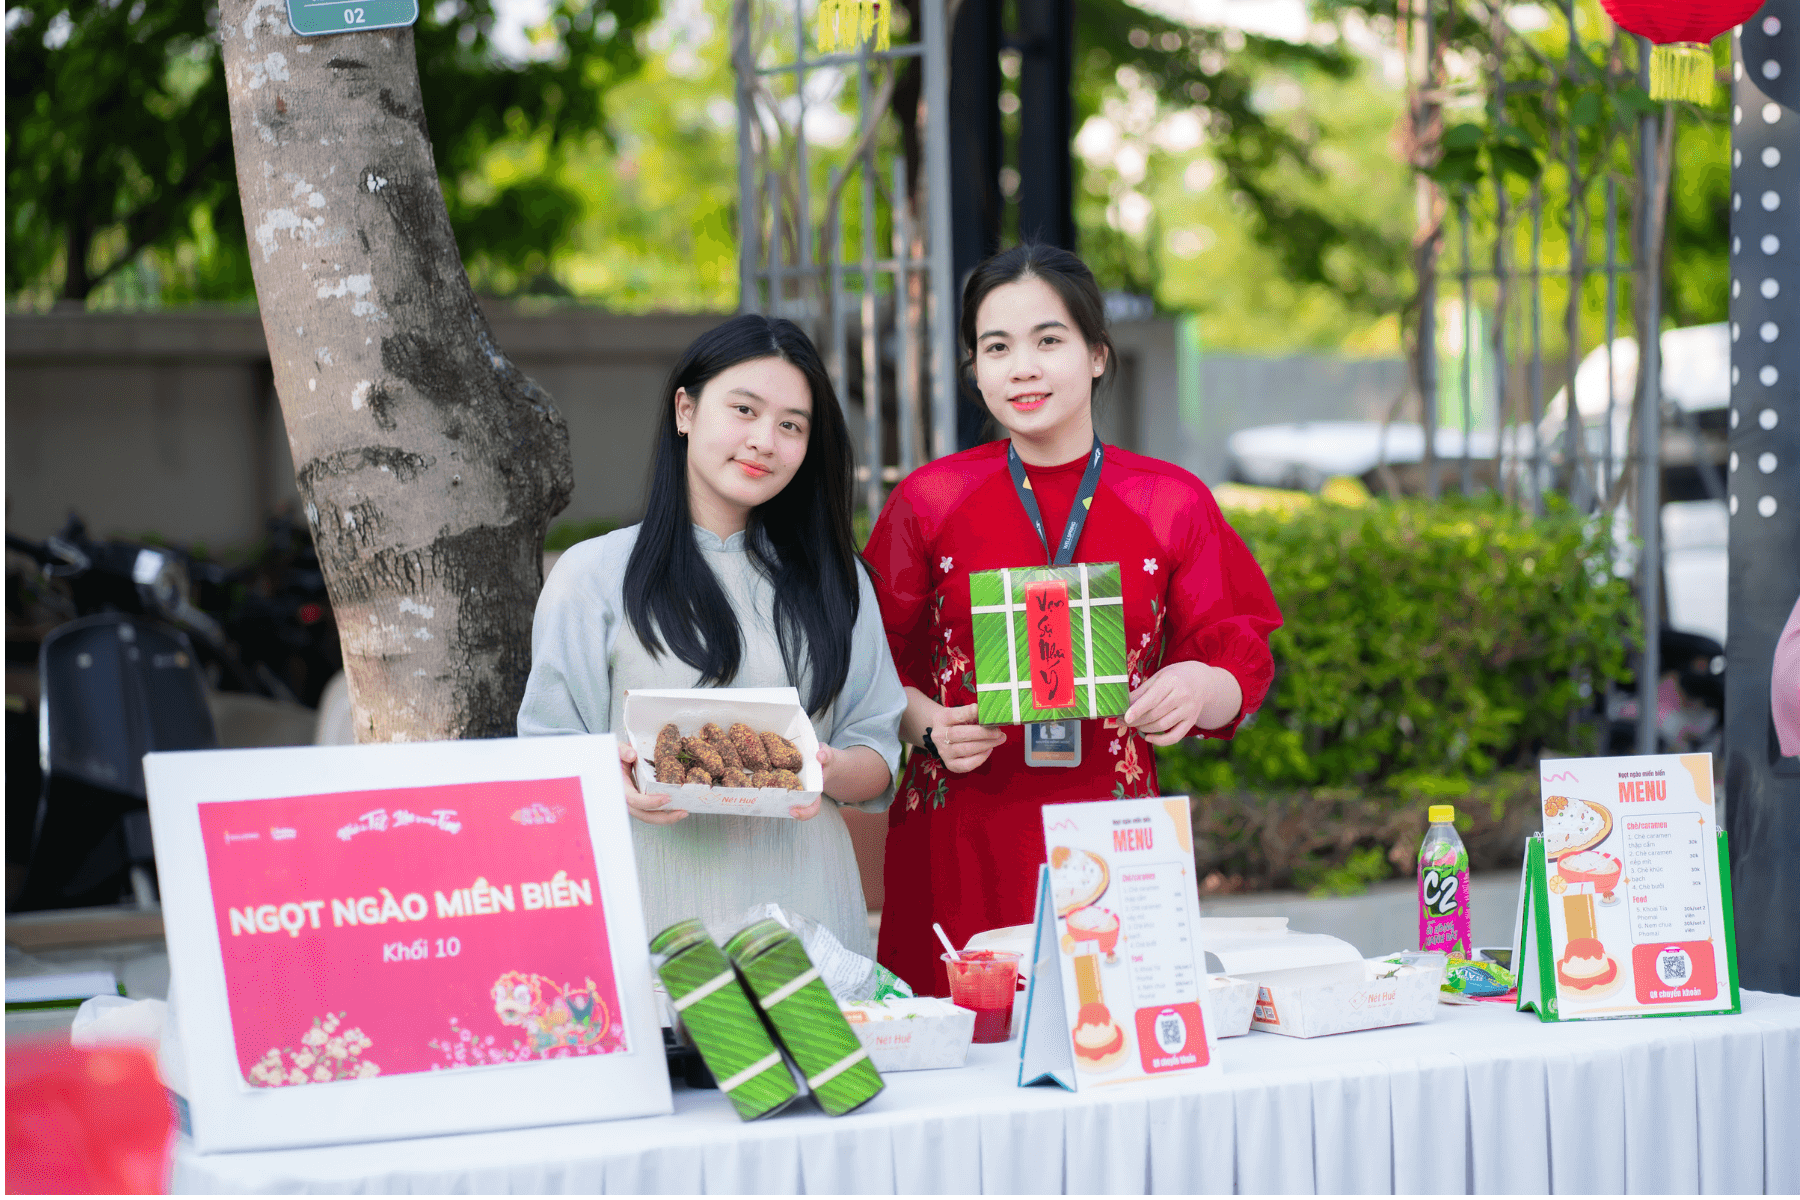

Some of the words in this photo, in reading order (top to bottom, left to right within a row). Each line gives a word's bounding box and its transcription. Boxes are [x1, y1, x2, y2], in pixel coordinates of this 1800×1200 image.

[343, 7, 366, 24] 02
[1618, 779, 1667, 803] MENU
[1113, 827, 1154, 853] MENU
[229, 899, 325, 938] NGỌT
[331, 887, 428, 928] NGÀO
[434, 876, 517, 920] MIỀN
[520, 869, 594, 911] BIỂN
[1423, 870, 1459, 914] C2
[1632, 895, 1648, 904] Food
[383, 937, 428, 962] Khối
[435, 936, 461, 958] 10
